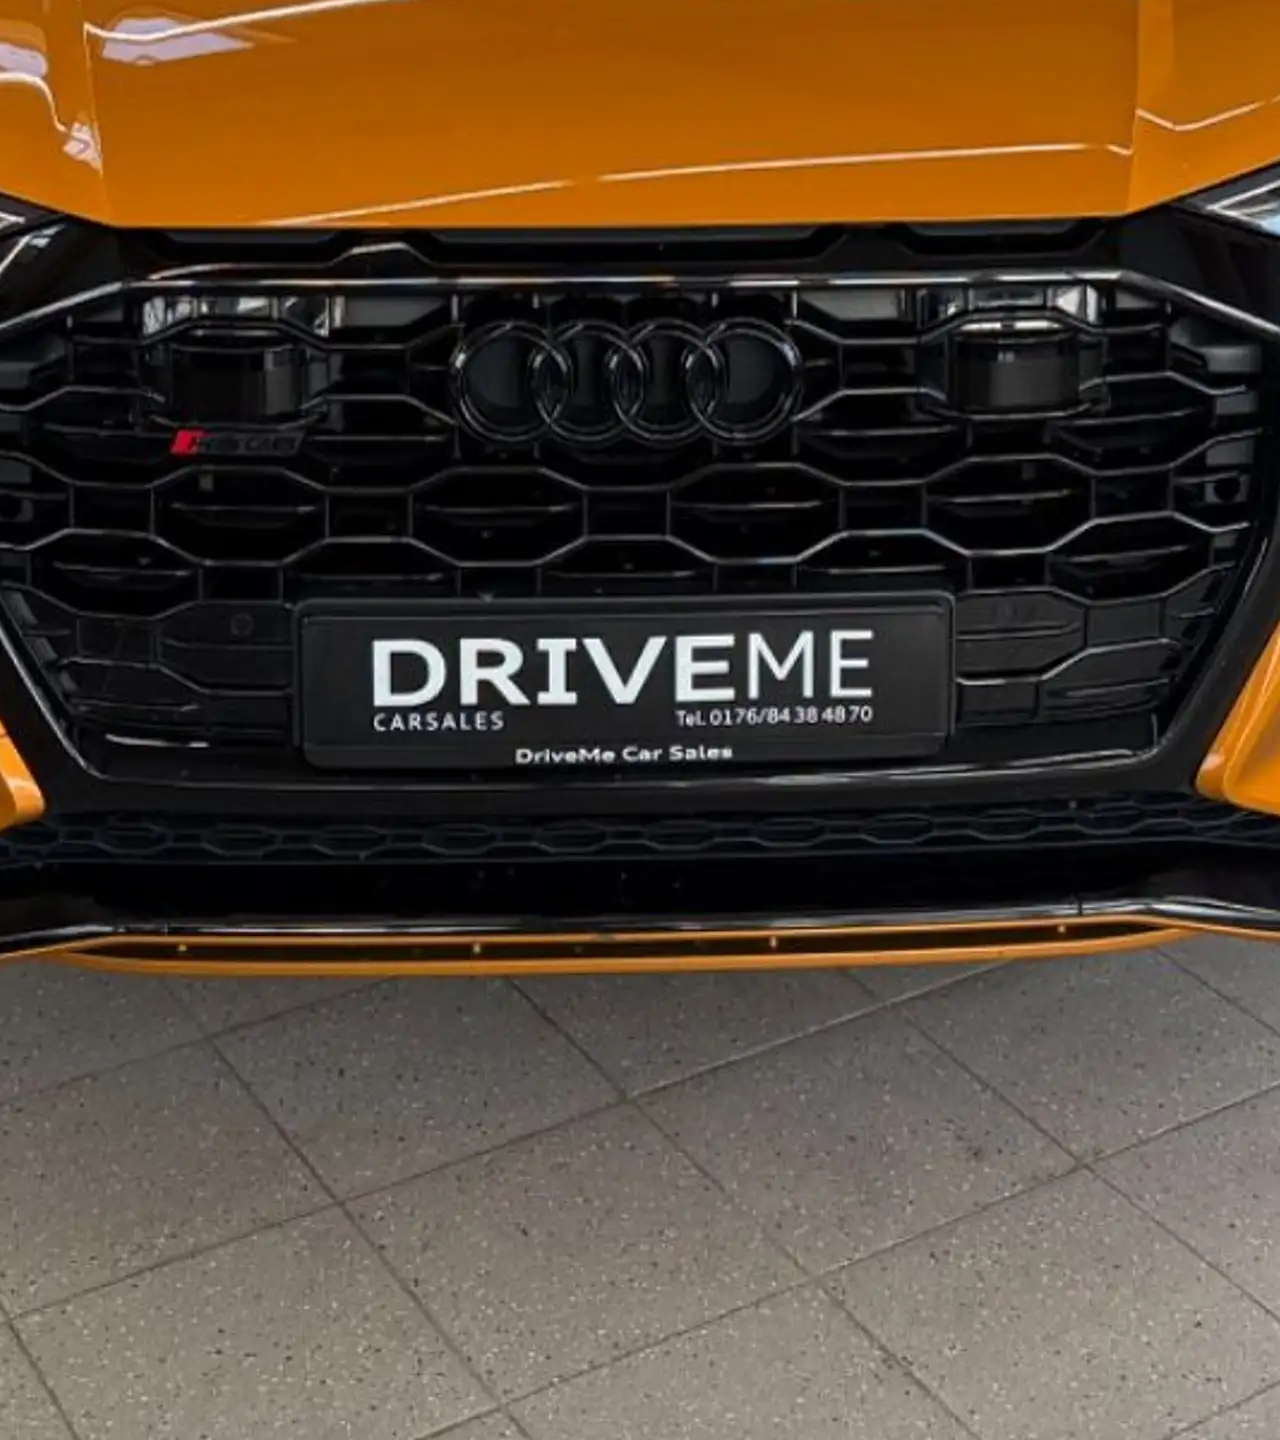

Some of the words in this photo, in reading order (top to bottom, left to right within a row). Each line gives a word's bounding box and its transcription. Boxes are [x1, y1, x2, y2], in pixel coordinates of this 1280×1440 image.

[372, 629, 874, 707] DRIVEME
[373, 711, 504, 731] CARSALES
[515, 747, 616, 764] DriveMe
[622, 746, 663, 761] Car
[669, 745, 733, 760] Sales
